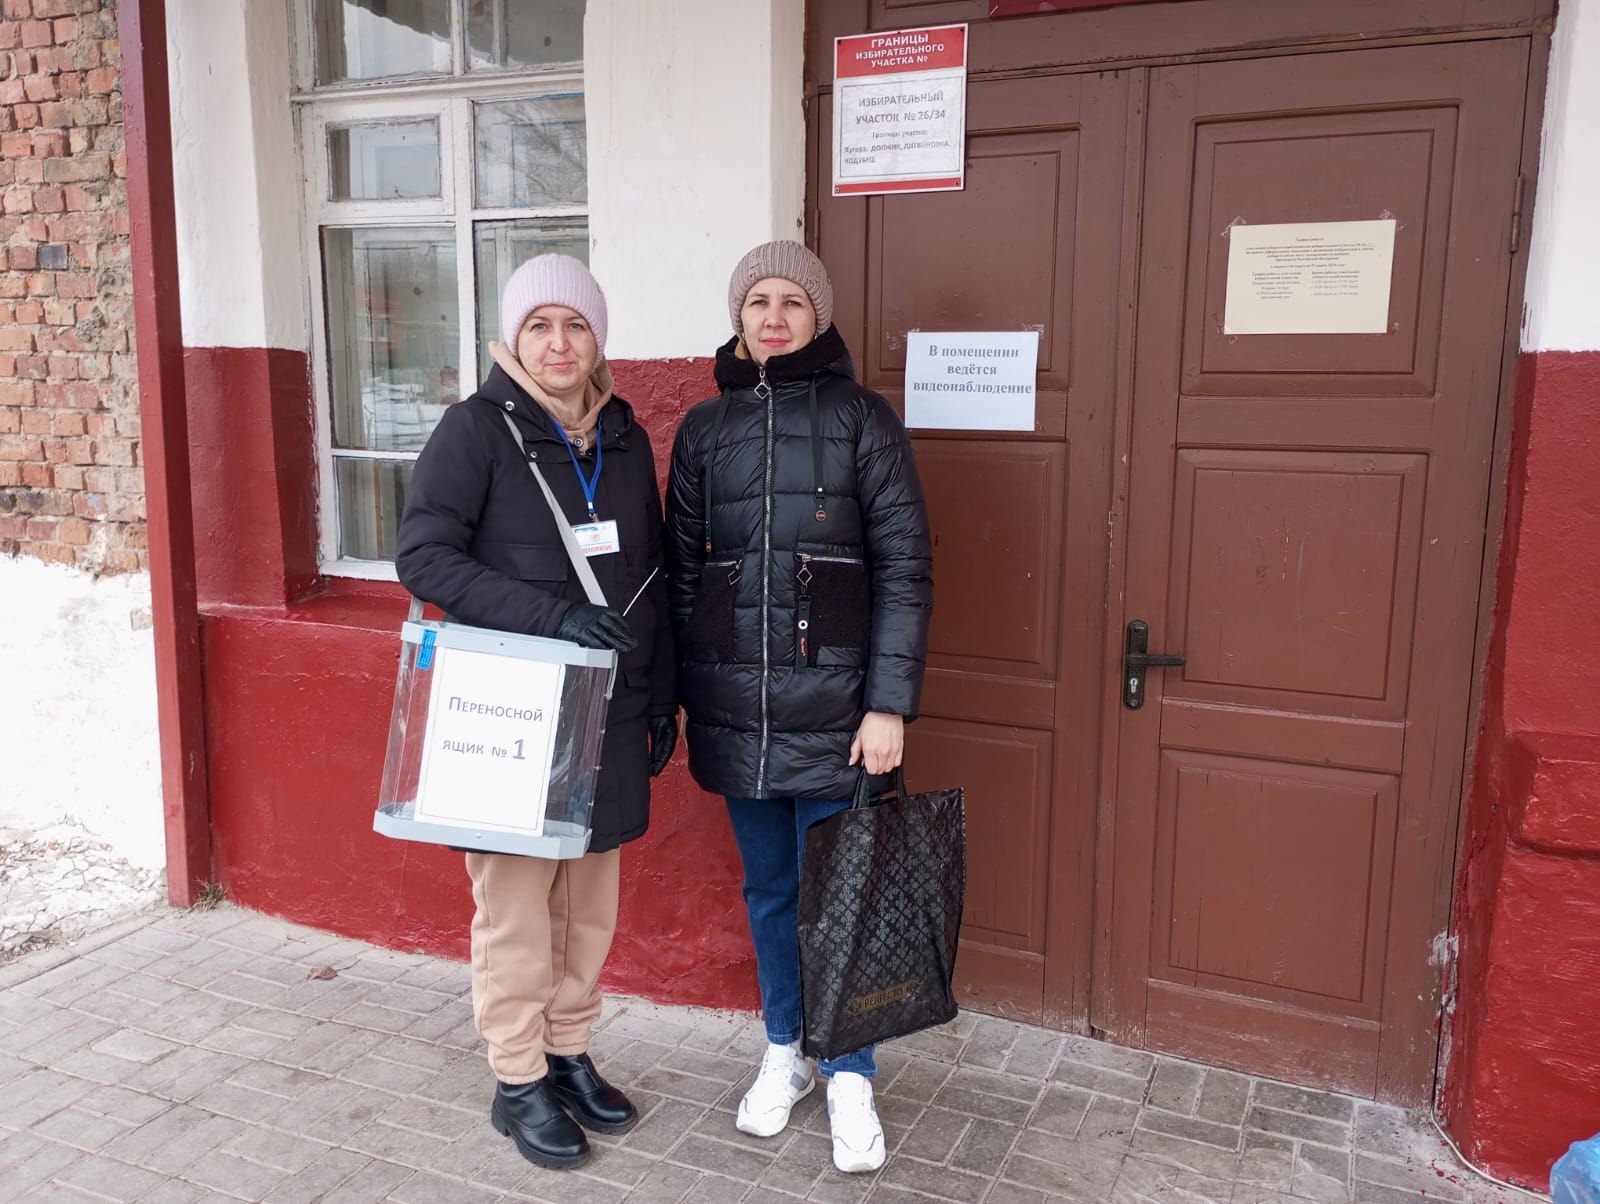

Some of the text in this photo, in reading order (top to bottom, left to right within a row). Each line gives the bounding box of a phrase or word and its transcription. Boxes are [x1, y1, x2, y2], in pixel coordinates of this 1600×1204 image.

[871, 34, 929, 48] ГРАНИЦЫ
[856, 44, 945, 60] ИЗБИРАТЕЛЬНОГО
[871, 55, 928, 67] УЧАСТКА №
[858, 91, 944, 107] ИЗБИРАТЕЛЬНЫЙ
[856, 109, 946, 124] УЧАСТОК № 26/34
[929, 345, 1019, 358] В помещении
[947, 363, 997, 376] ведётся
[913, 381, 1032, 394] видеонаблюдение
[491, 746, 508, 758] №
[512, 738, 526, 760] 1
